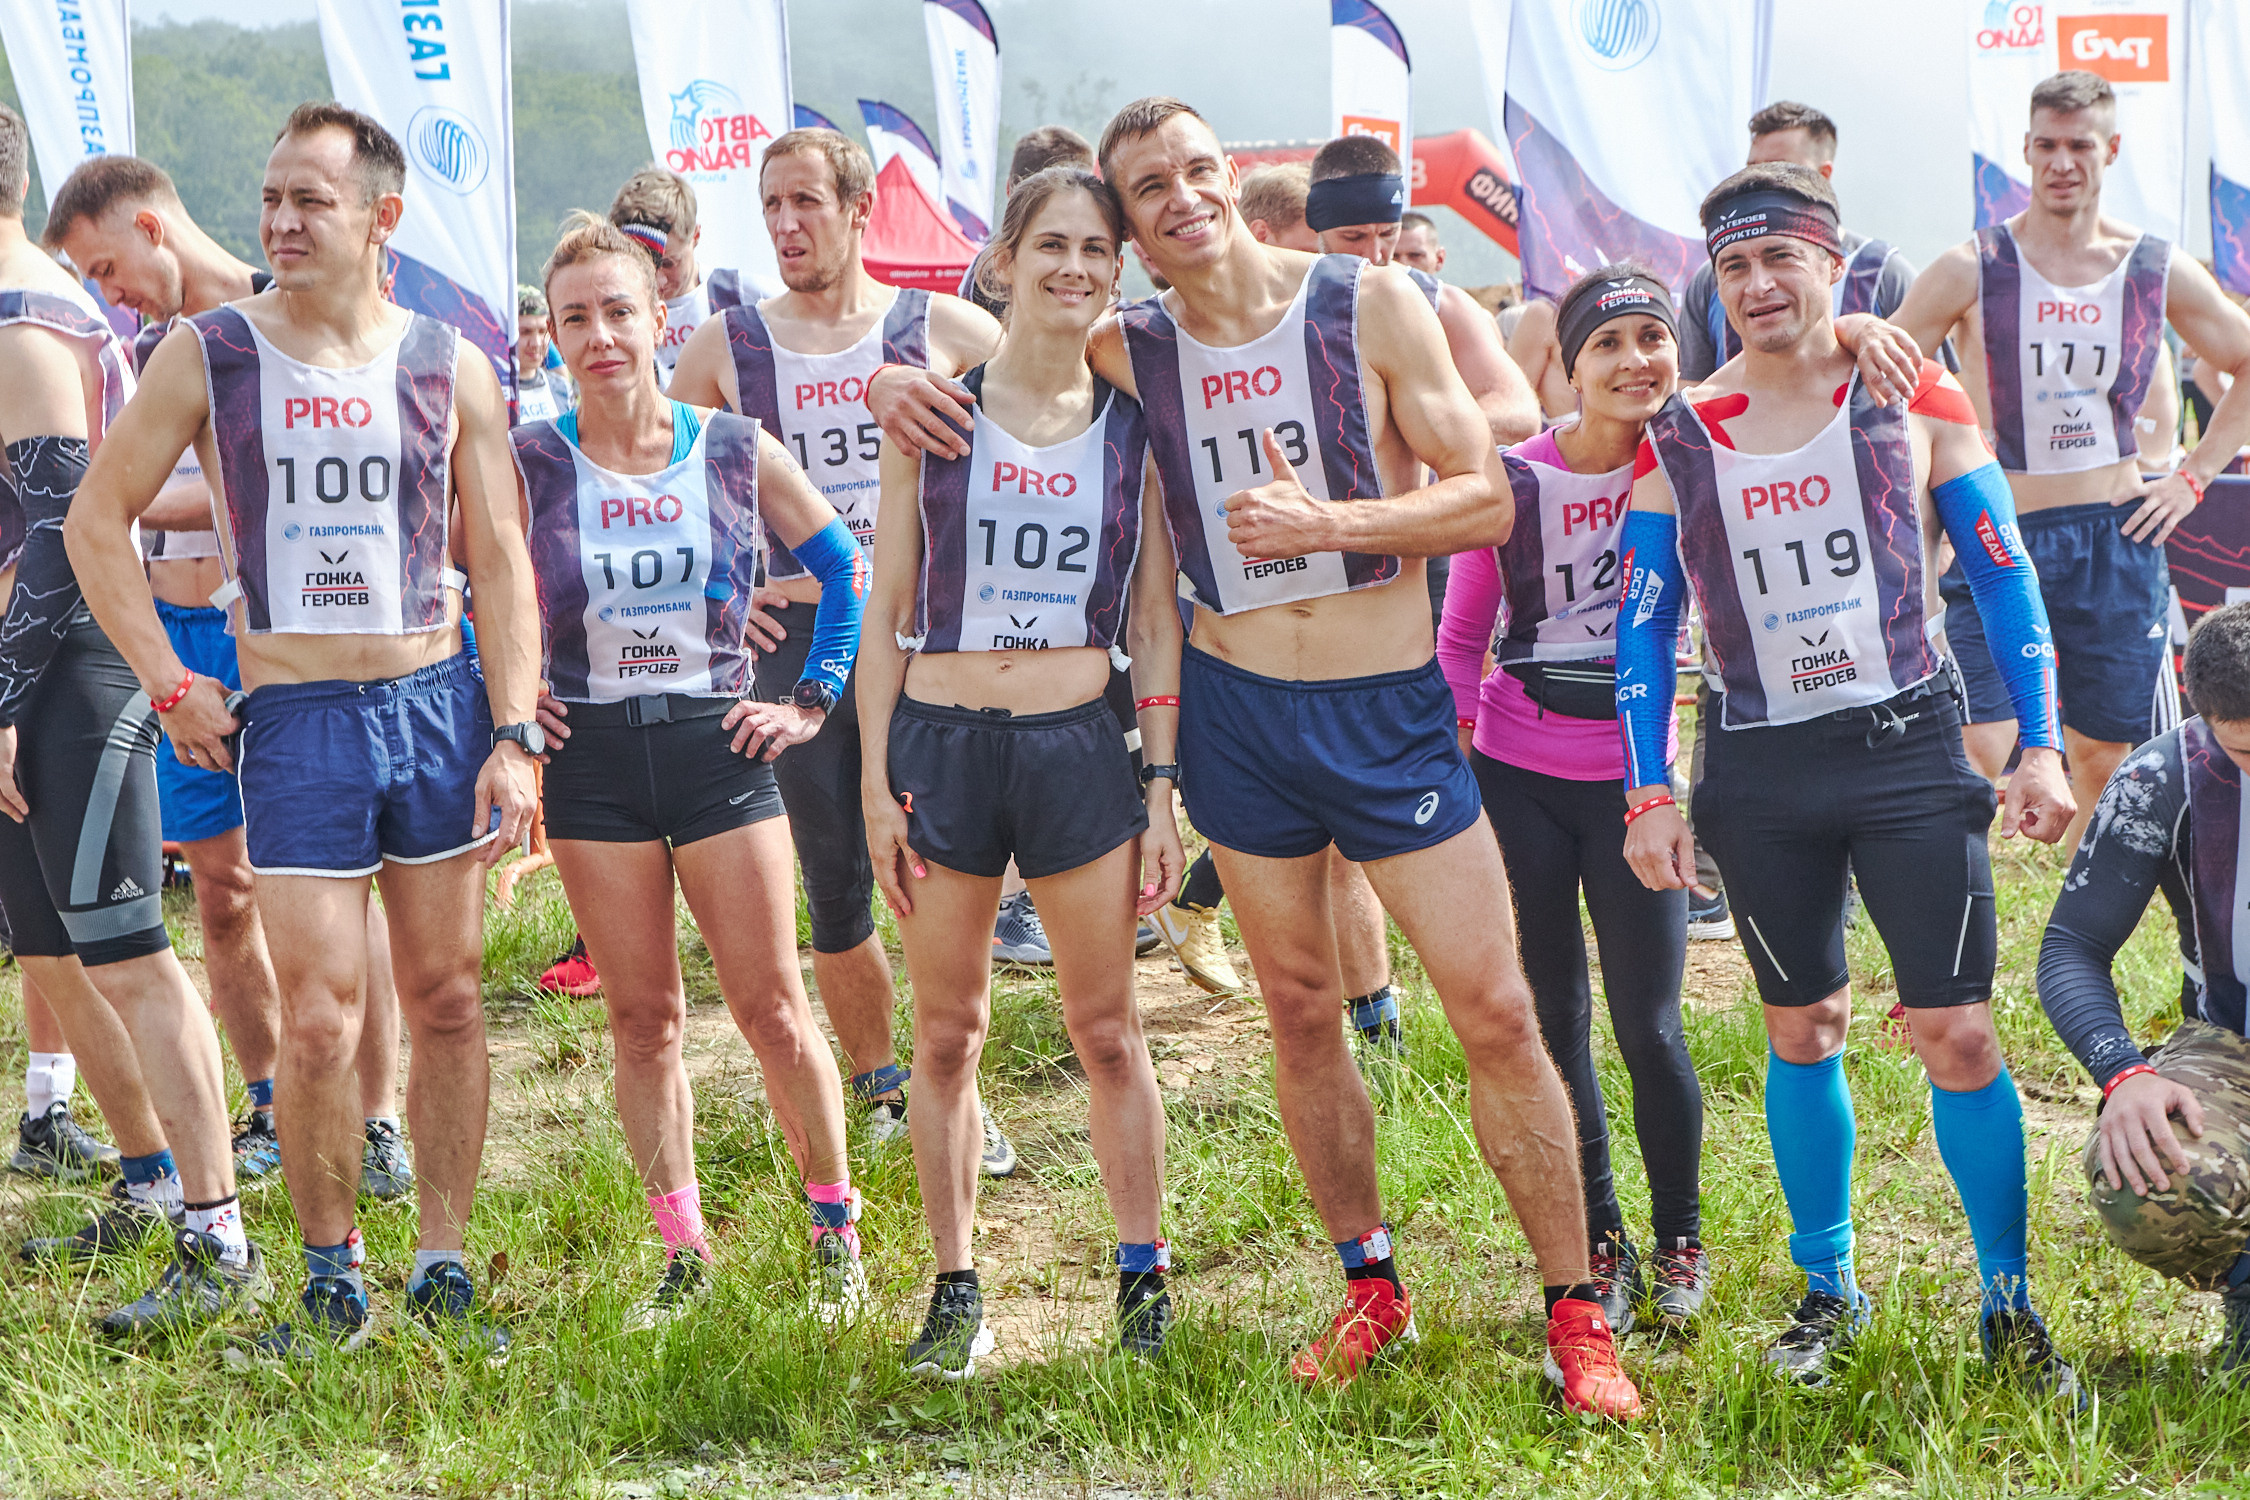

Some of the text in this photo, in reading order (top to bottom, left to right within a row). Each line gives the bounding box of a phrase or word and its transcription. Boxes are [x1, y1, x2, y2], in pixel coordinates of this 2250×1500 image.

[1470, 173, 1519, 223] ФИН
[1726, 212, 1767, 230] ГЕРОЕВ
[1600, 294, 1650, 311] ГЕРОЕВ
[1601, 287, 1647, 301] ГОНКА
[2037, 301, 2102, 325] PRO
[663, 325, 694, 348] RO
[2030, 342, 2106, 377] 177
[795, 376, 864, 410] PRO
[1201, 365, 1282, 410] PRO
[285, 396, 373, 429] PRO
[2053, 421, 2093, 435] ГОНКА
[792, 422, 881, 470] 135
[1201, 419, 1309, 483] 113
[2050, 436, 2097, 451] ГЕРОЕВ
[276, 455, 391, 504] 100
[992, 461, 1077, 498] PRO
[1741, 474, 1831, 521] PRO
[600, 493, 684, 530] PRO
[309, 524, 385, 537] ГАЗПРОМБАНК
[1977, 520, 2008, 564] TEAM
[1998, 523, 2022, 556] OCR
[978, 518, 1091, 573] 102
[593, 547, 694, 590] 107
[1243, 556, 1308, 581] ГЕРОЕВ
[1555, 549, 1618, 602] 12
[1742, 528, 1862, 596] 119
[305, 571, 365, 586] ГОНКА
[1627, 567, 1645, 600] OCR
[301, 592, 370, 607] ГЕРОЕВ
[620, 601, 692, 618] ГАЗПРОМБАНК
[1002, 589, 1077, 605] ГАЗПРОМБАНК
[1640, 584, 1659, 615] RUS
[1786, 596, 1863, 624] ГАЗПРОМБАНК
[622, 644, 678, 660] ГОНКА
[993, 634, 1050, 651] ГОНКА
[2021, 642, 2056, 659] OC
[618, 663, 680, 679] ГЕРОЕВ
[1791, 649, 1851, 673] ГОНКА
[1792, 667, 1858, 694] ГЕРОЕВ
[110, 887, 145, 901] adidas
